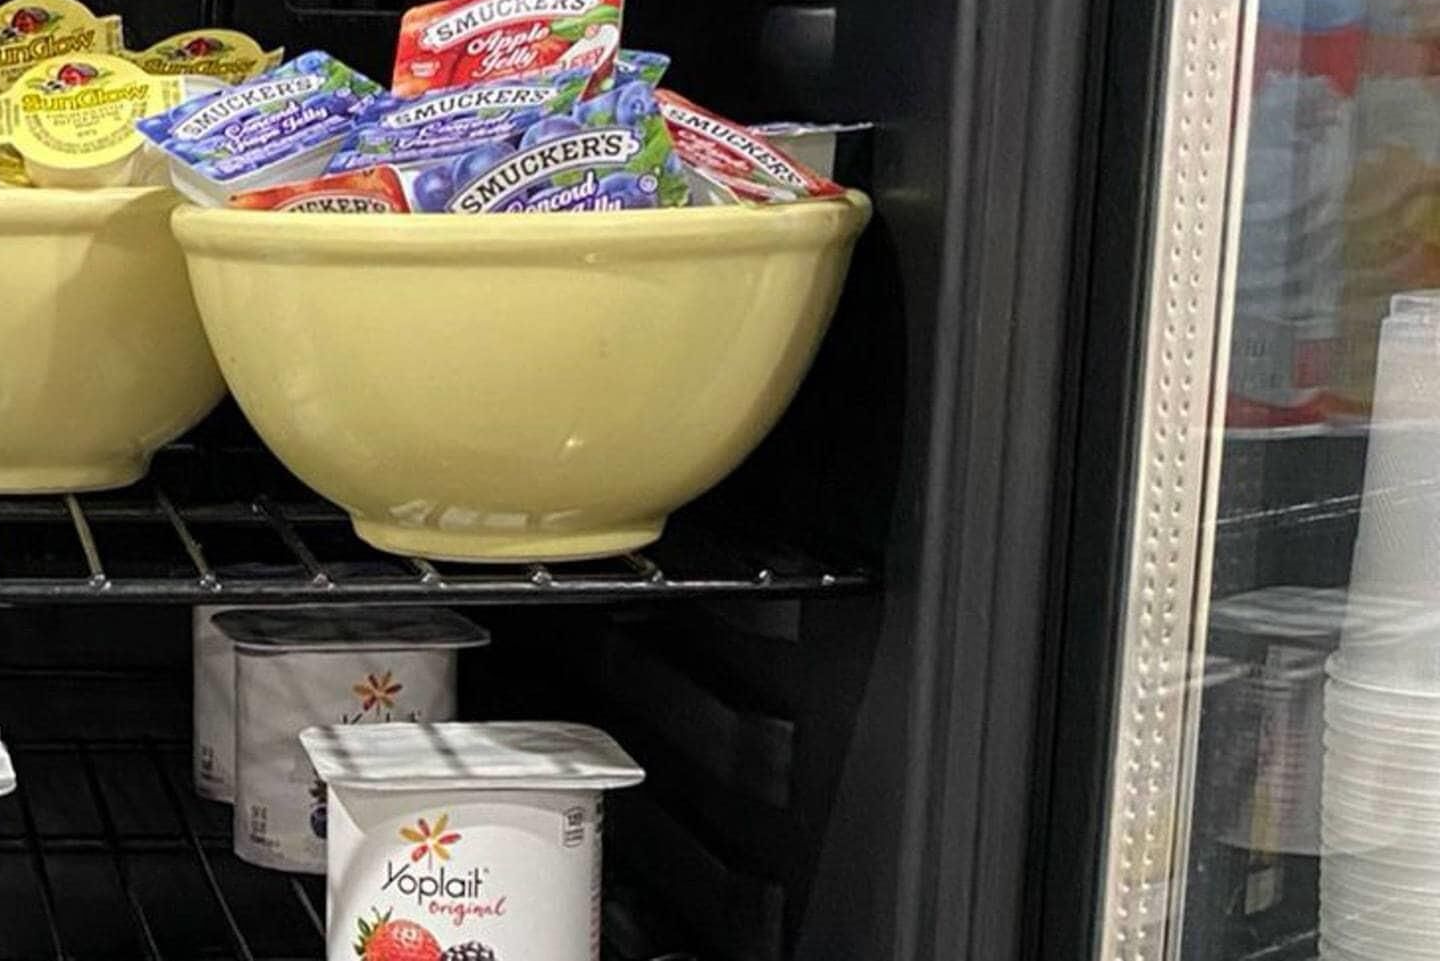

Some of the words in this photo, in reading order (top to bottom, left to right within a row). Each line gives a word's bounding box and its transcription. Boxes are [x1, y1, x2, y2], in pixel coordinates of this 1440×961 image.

[466, 22, 550, 56] Apple
[471, 48, 538, 79] Jelly
[21, 83, 150, 113] SunGlow
[182, 77, 312, 137] SMUCKER'S
[461, 133, 623, 214] SMUCKER'S
[382, 861, 483, 905] Yoplait
[428, 897, 507, 926] original
